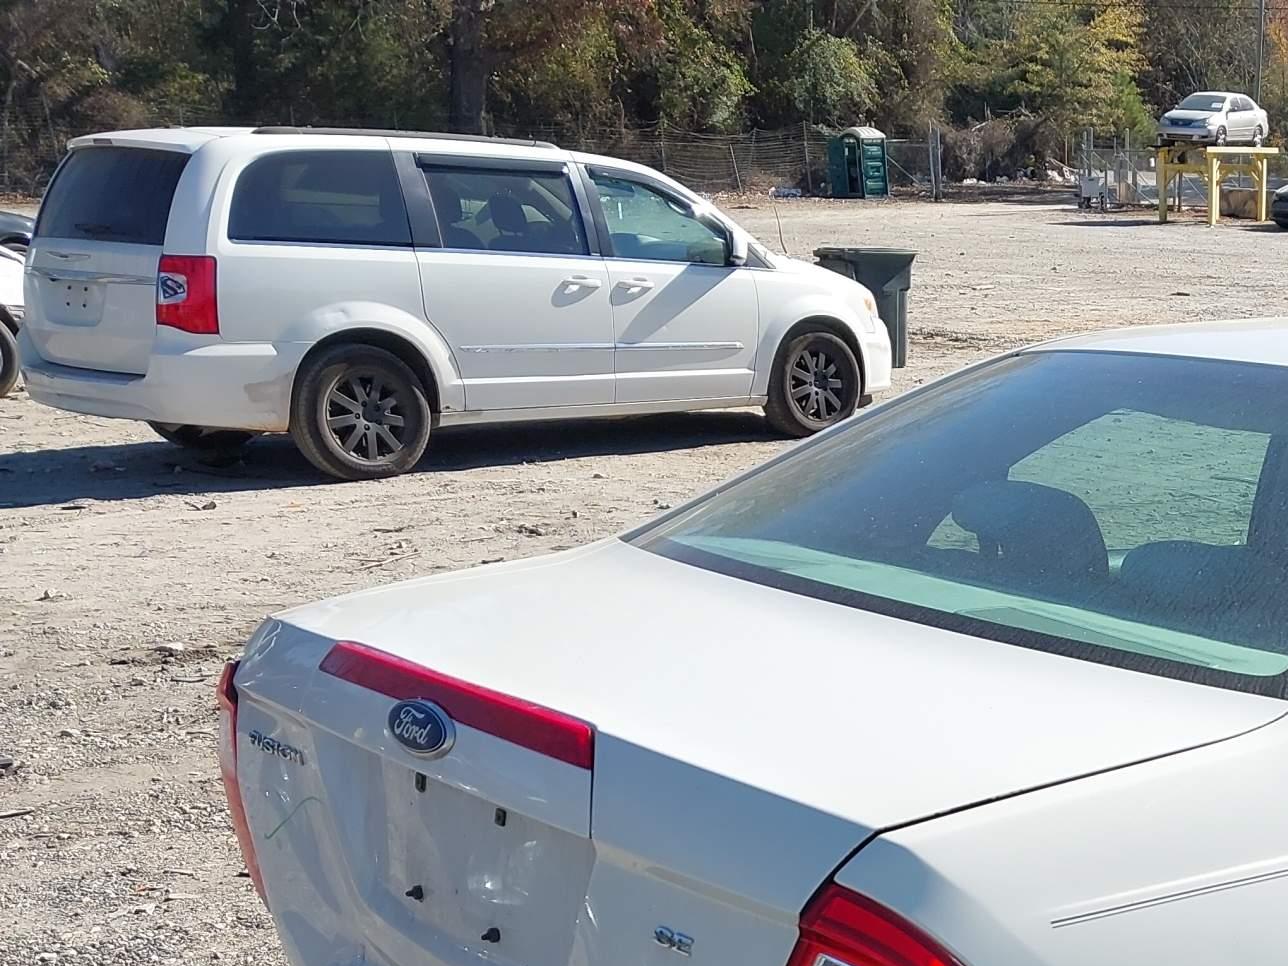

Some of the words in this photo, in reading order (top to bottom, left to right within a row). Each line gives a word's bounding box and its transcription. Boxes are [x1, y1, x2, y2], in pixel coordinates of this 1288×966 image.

[393, 706, 432, 745] Ford
[248, 729, 305, 766] FUSION
[655, 926, 695, 956] SE
